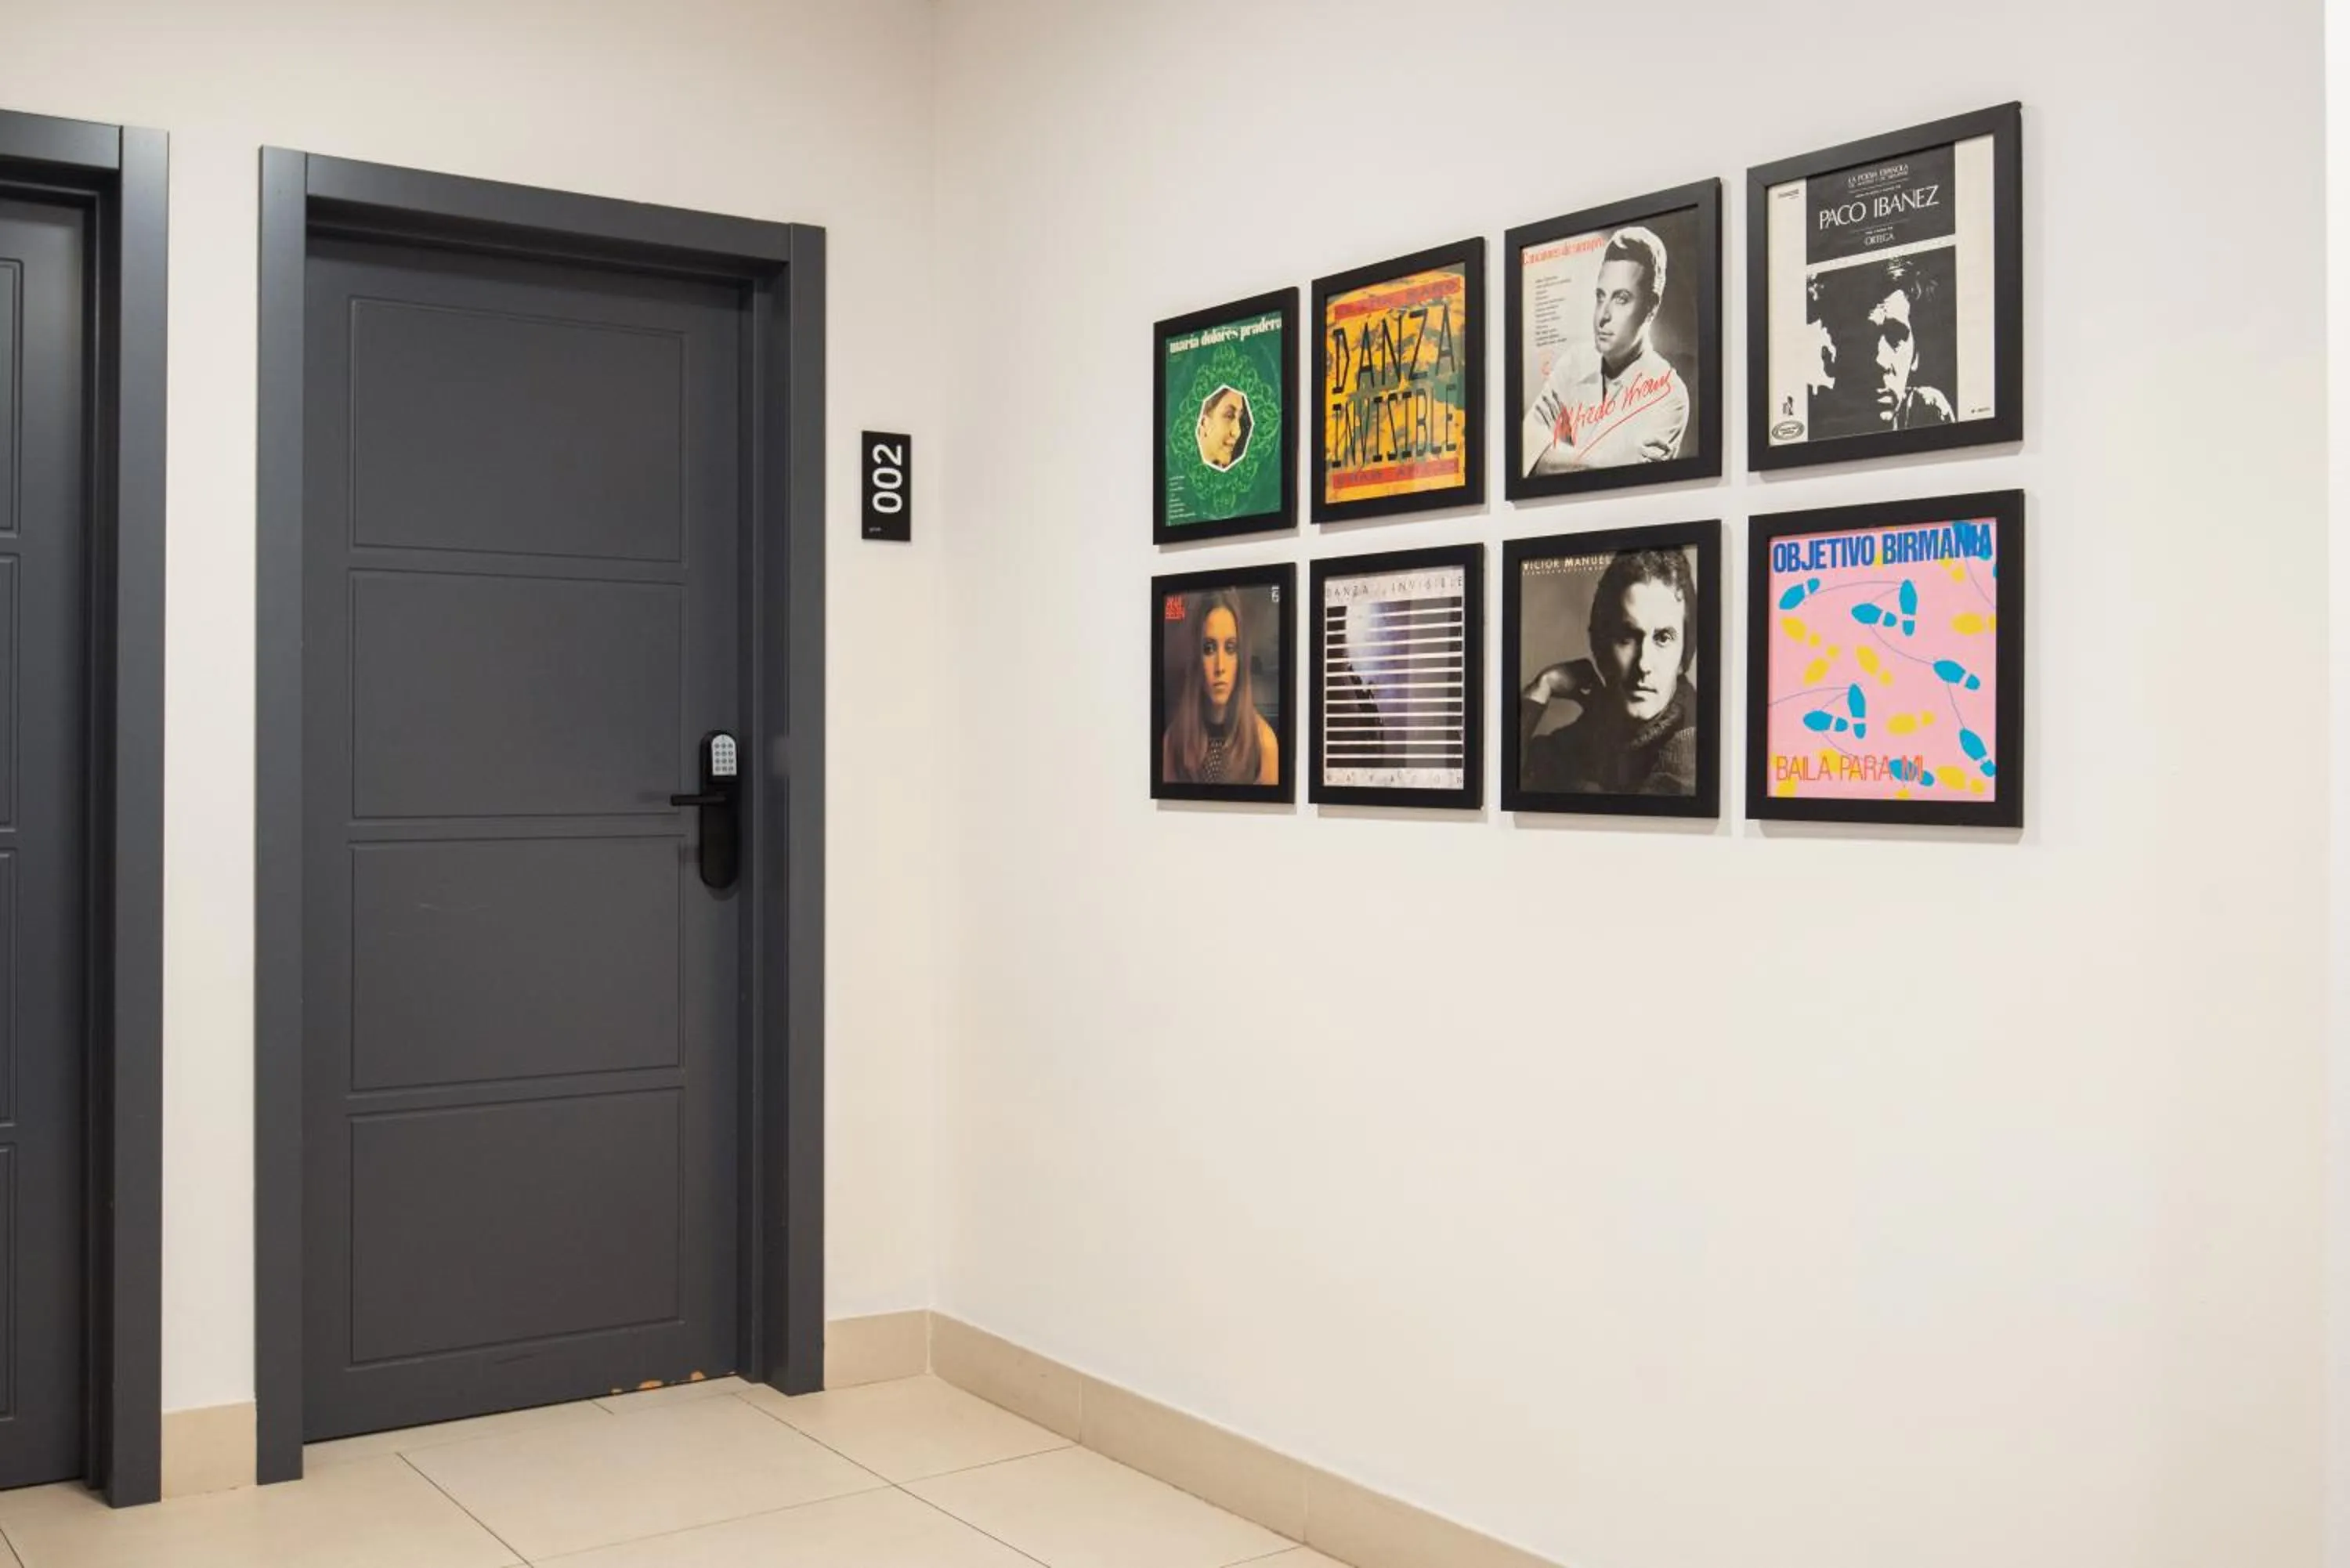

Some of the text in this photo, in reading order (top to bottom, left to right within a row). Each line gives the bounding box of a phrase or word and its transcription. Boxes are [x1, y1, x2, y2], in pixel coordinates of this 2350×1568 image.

[1819, 201, 1867, 230] PACO
[1332, 302, 1455, 394] DANZA
[1332, 383, 1457, 468] INVISIBLE
[872, 443, 903, 514] 002
[1522, 559, 1560, 572] VICTOR
[1564, 554, 1611, 568] MANUEL
[1773, 523, 1993, 573] OBJETIVO BIRMANIA
[1776, 754, 1832, 782] BAILA
[1840, 753, 1893, 782] PARA
